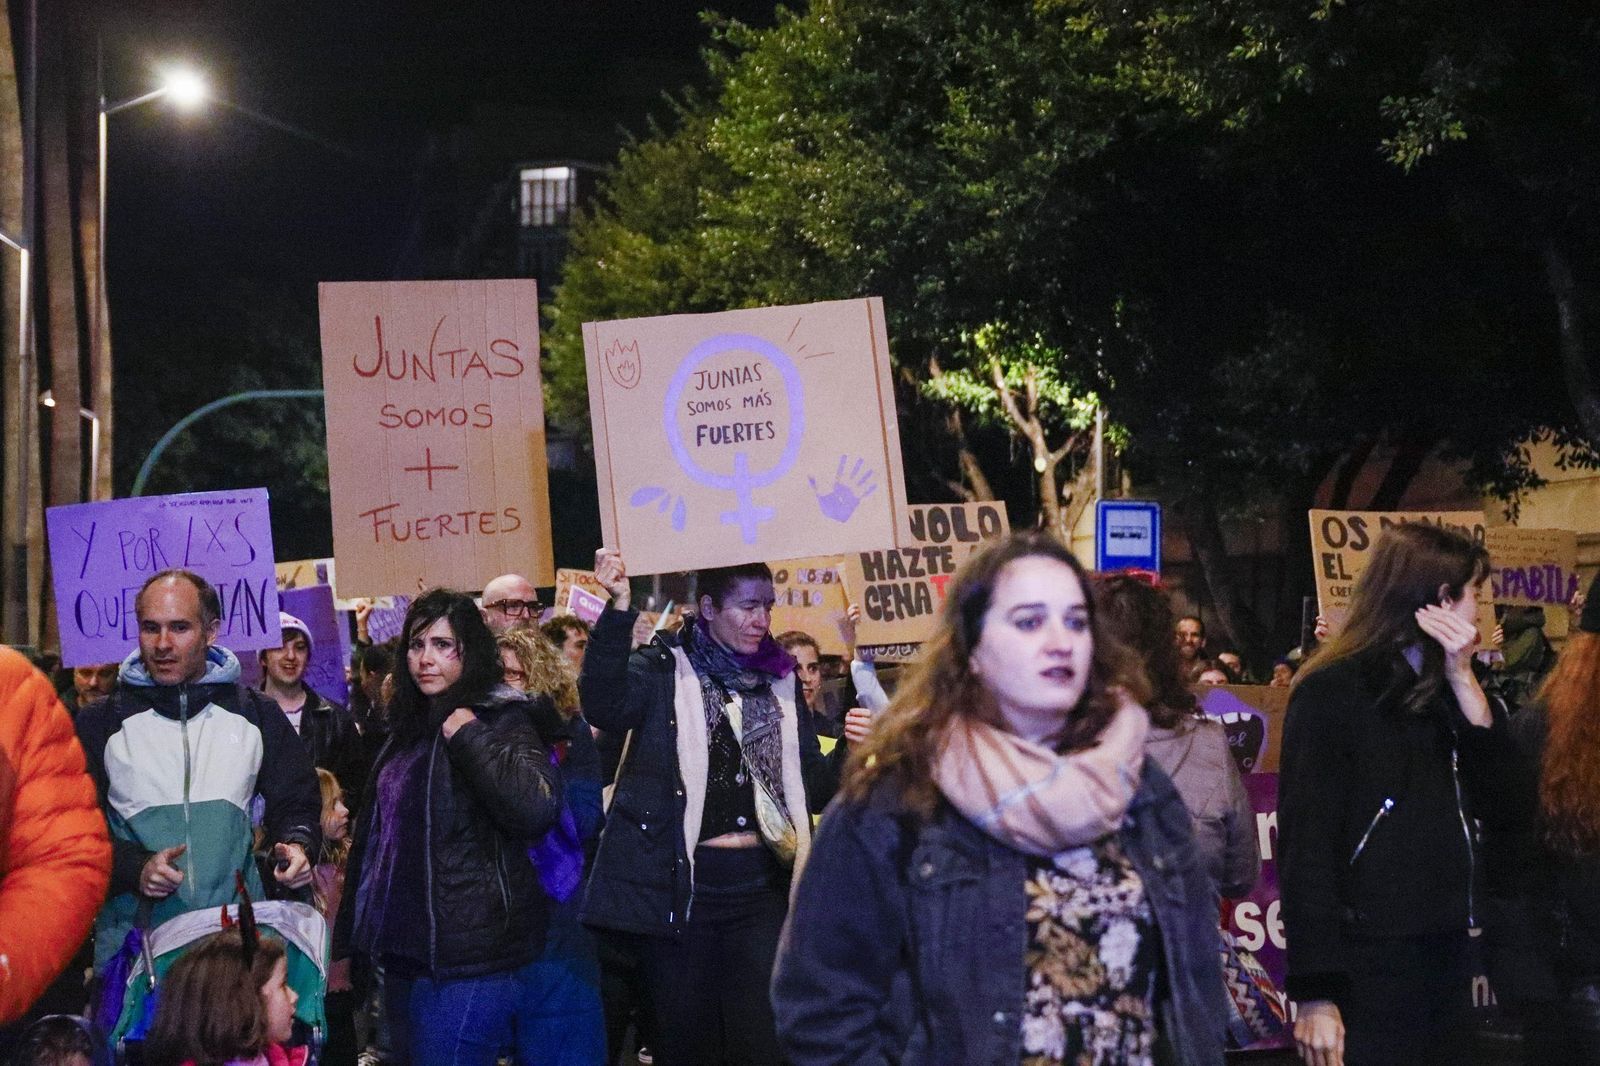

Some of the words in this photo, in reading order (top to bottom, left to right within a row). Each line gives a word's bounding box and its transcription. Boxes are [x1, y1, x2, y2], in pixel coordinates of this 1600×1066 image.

[353, 315, 524, 383] JUNTAS
[693, 363, 763, 391] JUNTAS
[378, 404, 493, 429] SOMOS
[687, 399, 732, 416] SOMOS
[742, 388, 773, 409] MÁS
[696, 421, 776, 447] FUERTES
[359, 503, 522, 543] FUERTES
[1321, 515, 1370, 551] OS
[71, 521, 96, 579] Y
[118, 527, 170, 571] POR
[183, 511, 256, 567] LXS
[859, 546, 956, 582] HAZTE
[1321, 552, 1353, 580] EL
[864, 581, 933, 623] CENA
